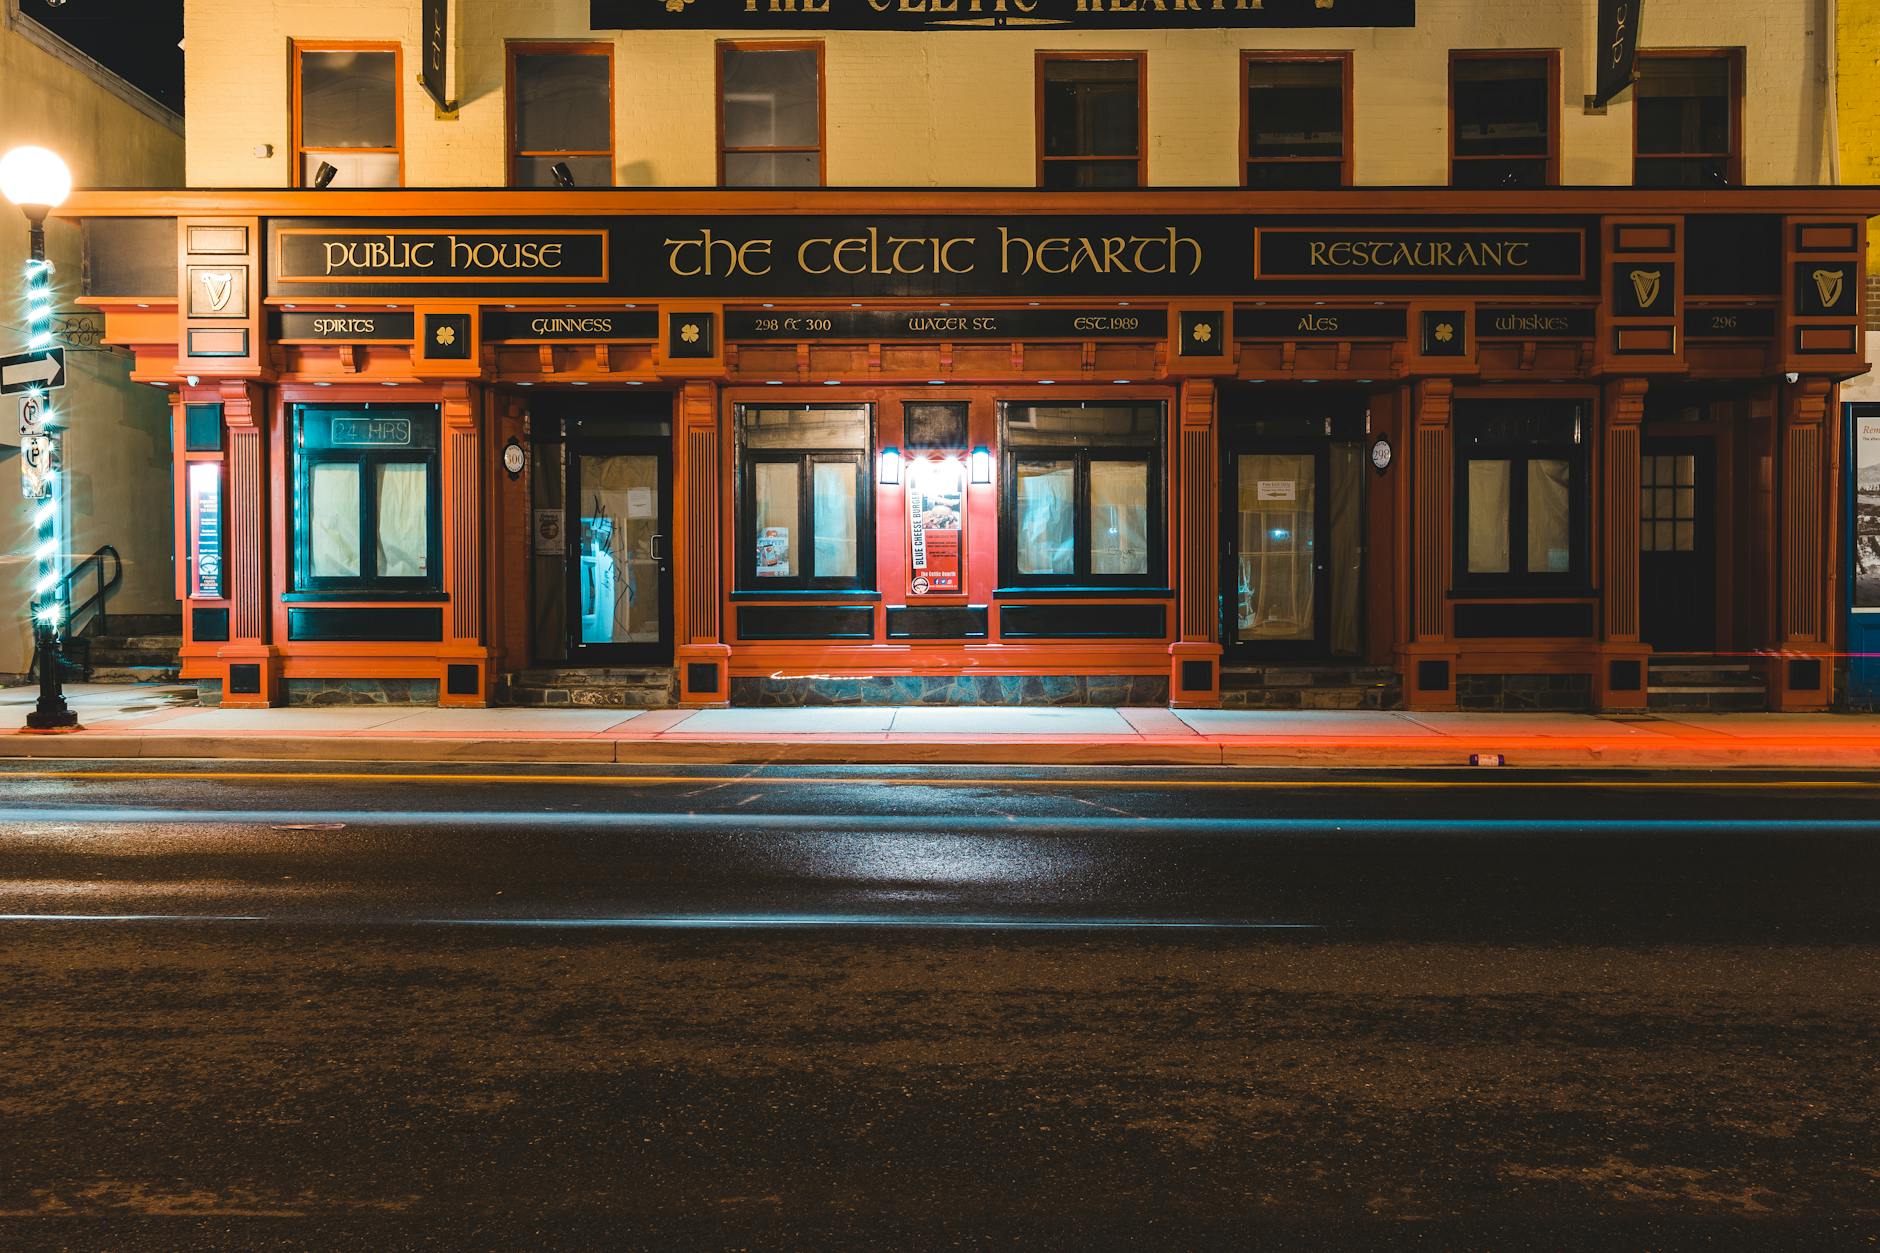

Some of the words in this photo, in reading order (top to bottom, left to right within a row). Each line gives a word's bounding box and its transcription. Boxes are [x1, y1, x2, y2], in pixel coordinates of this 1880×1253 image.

[323, 235, 435, 275] PUBLIC
[448, 235, 563, 269] HOUSE
[664, 228, 773, 278] THE
[797, 226, 976, 275] CELTIC
[997, 226, 1203, 276] HEARTH
[1309, 241, 1529, 267] RESTAURANT
[313, 318, 375, 336] SPIRITS
[531, 318, 613, 334] GUINNESS
[754, 319, 779, 331] 298
[805, 318, 832, 331] 300
[908, 317, 968, 331] WATER
[972, 317, 998, 331] ST.
[1298, 313, 1338, 331] ALES
[1495, 313, 1569, 331] WHISKIES
[1712, 316, 1737, 329] 296
[334, 422, 358, 440] 24
[368, 422, 408, 441] HRS
[1373, 448, 1390, 460] 298
[912, 520, 923, 546] CHEESE
[914, 548, 924, 566] BLUE
